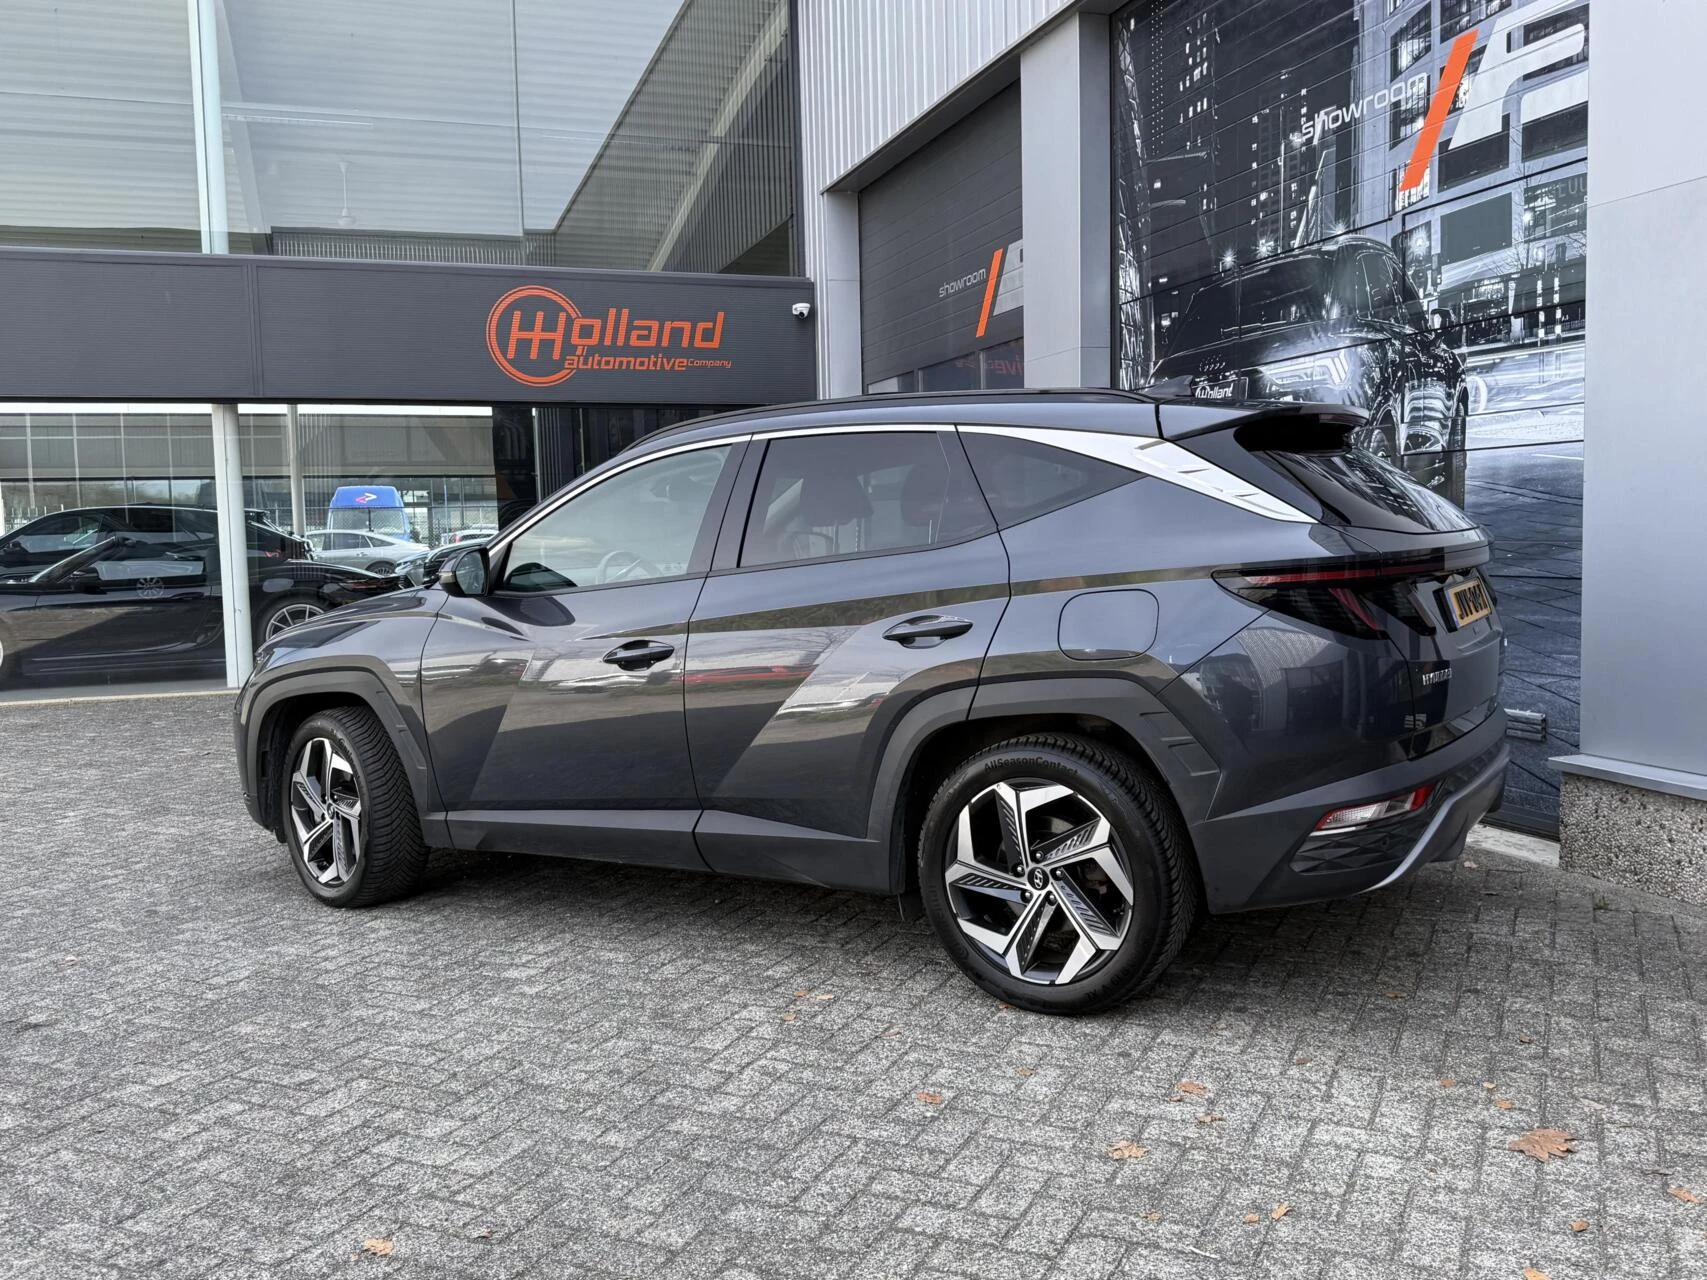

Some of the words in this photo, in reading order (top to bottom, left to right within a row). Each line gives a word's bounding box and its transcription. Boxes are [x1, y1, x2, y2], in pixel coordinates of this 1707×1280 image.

[1301, 72, 1427, 140] showroom
[939, 268, 987, 298] showroom
[564, 353, 687, 371] automotive
[687, 358, 733, 369] Company
[984, 756, 1079, 776] AllSeasonContact
